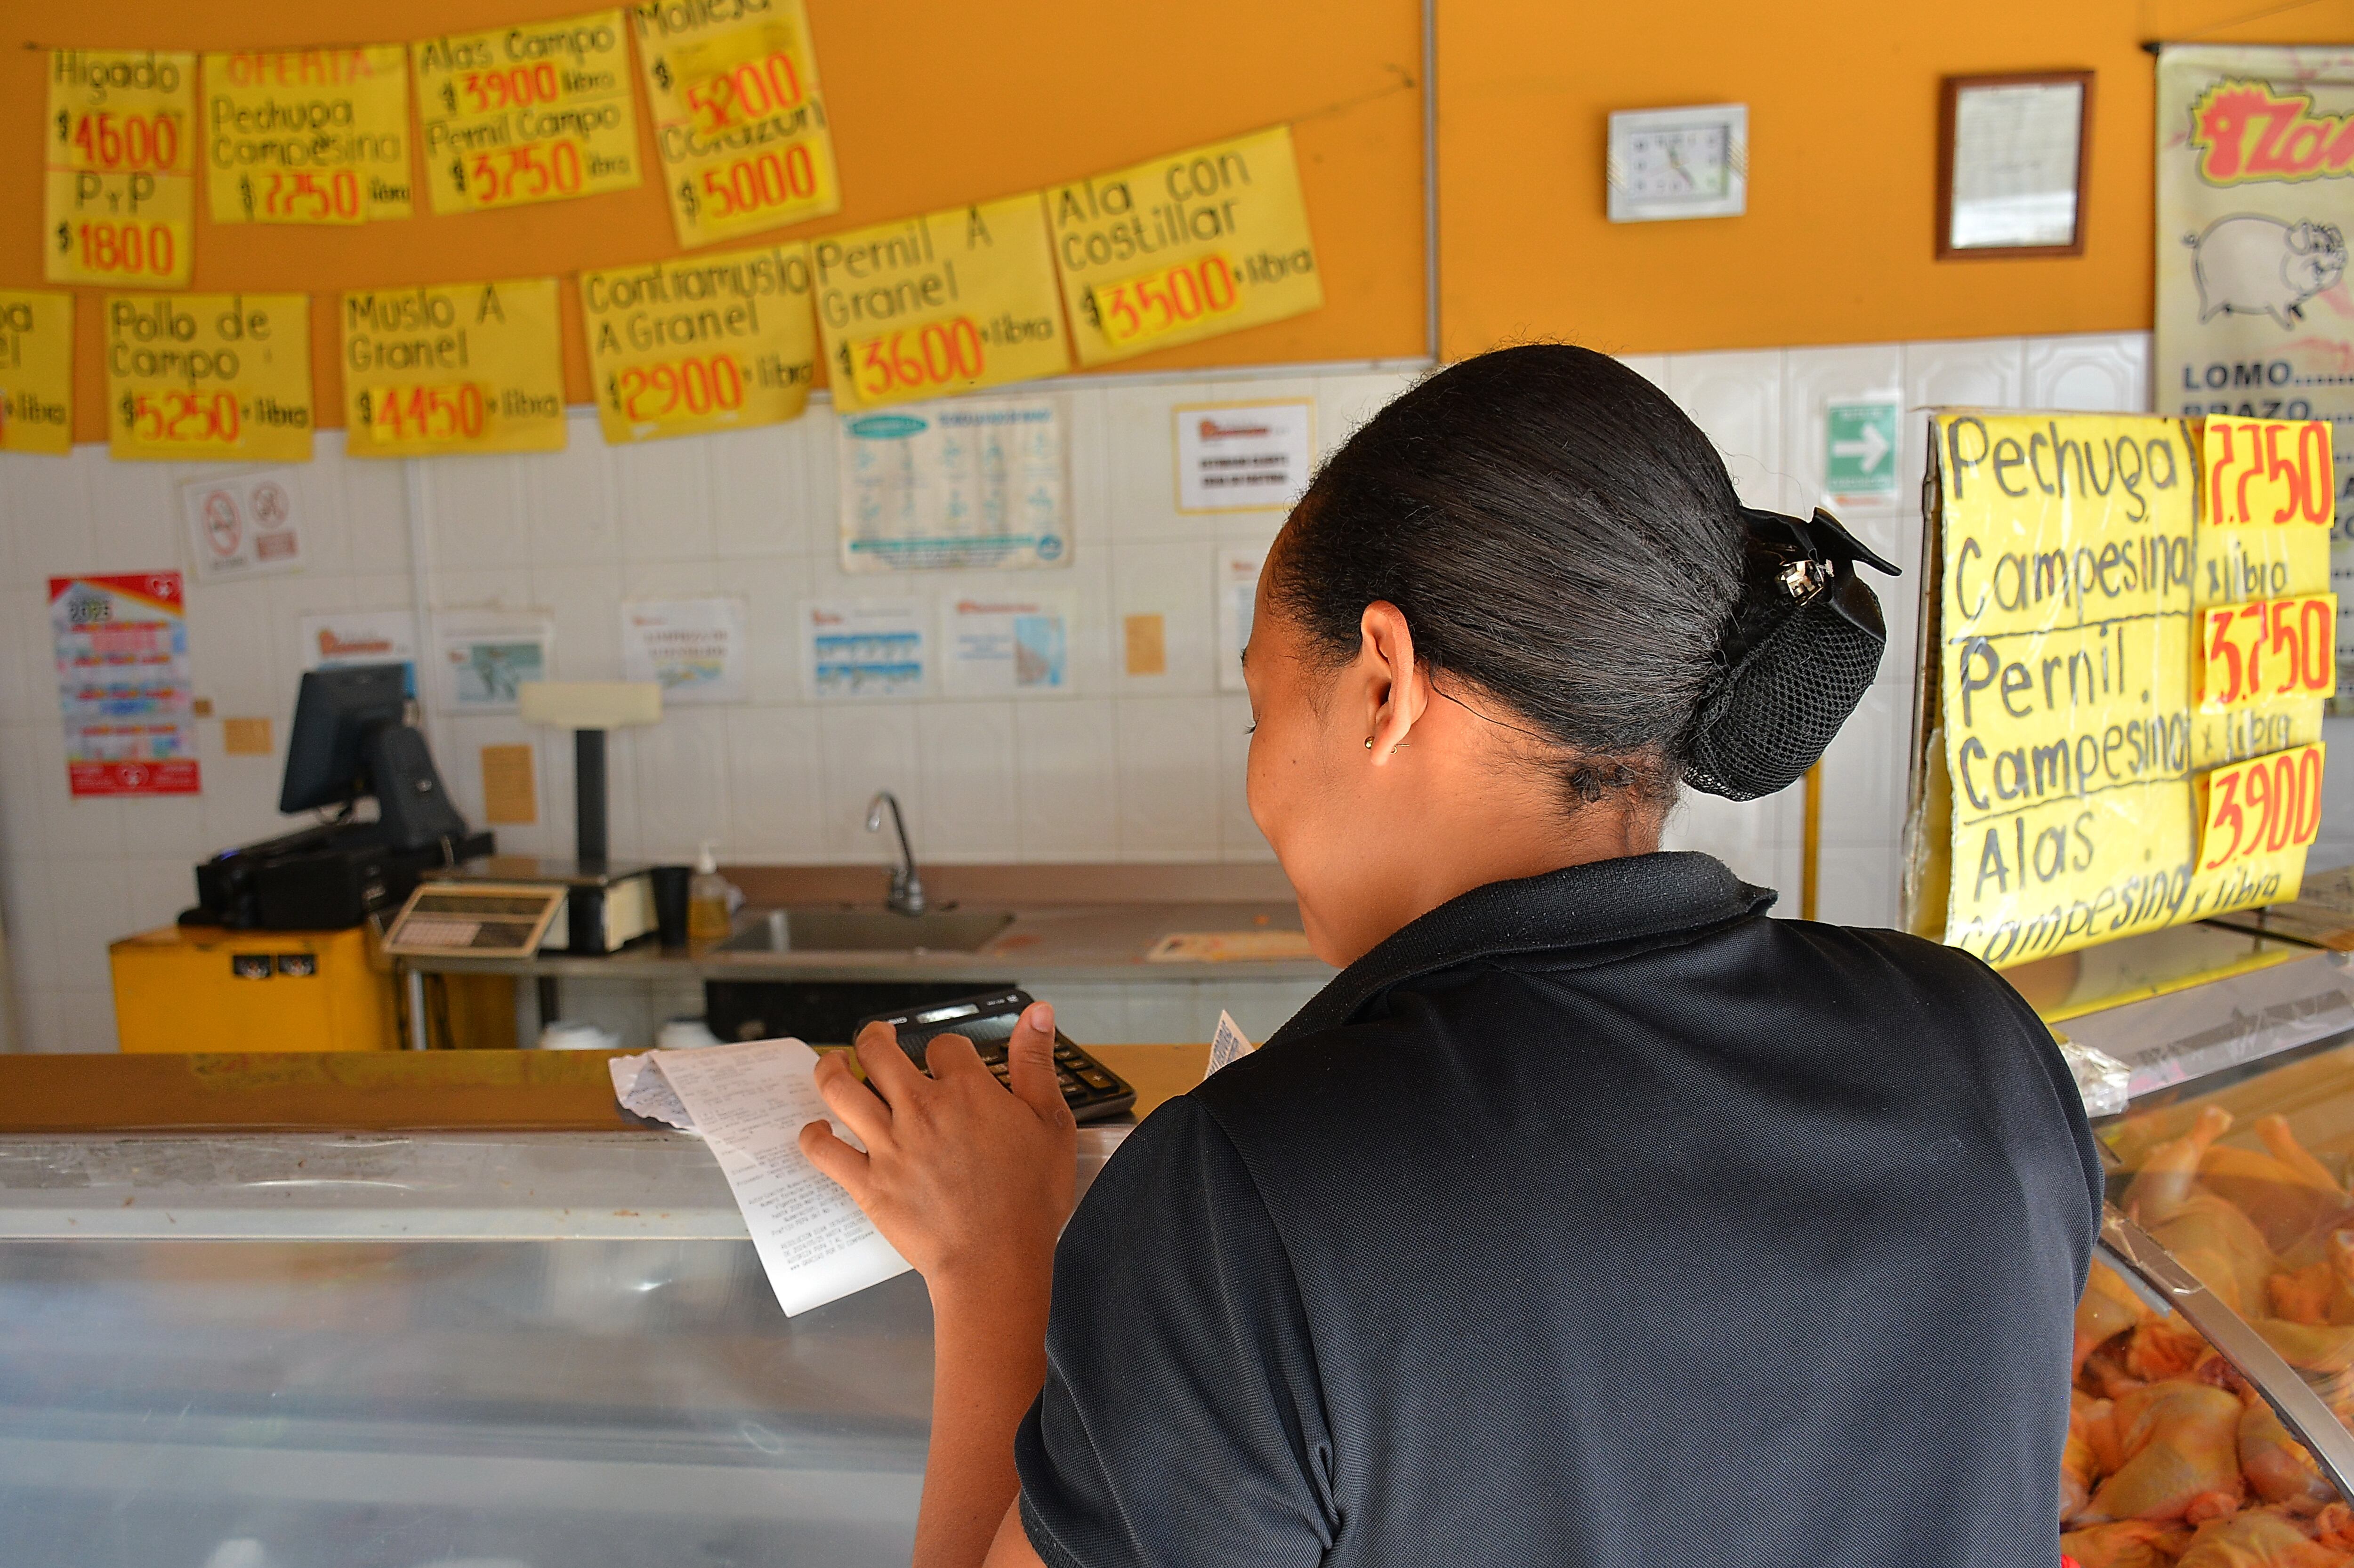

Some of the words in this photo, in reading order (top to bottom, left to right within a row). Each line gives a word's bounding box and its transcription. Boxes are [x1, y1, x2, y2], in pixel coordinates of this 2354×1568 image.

[421, 37, 494, 74] Alas
[505, 26, 614, 67] Campo
[210, 94, 355, 141] Pechuga
[426, 113, 512, 158] Pernil
[516, 103, 621, 141] Campo
[211, 131, 401, 169] Campesina
[1059, 178, 1134, 229] Ala
[816, 213, 935, 286] Pernil
[967, 205, 994, 250] A
[347, 287, 456, 332] Muslo
[476, 283, 506, 325] A
[586, 247, 811, 314] Contramuslo
[822, 258, 959, 330] Granel
[111, 300, 198, 342] Pollo
[215, 293, 272, 341] de
[596, 321, 623, 357] A
[627, 299, 760, 352] Granel
[109, 341, 240, 388] Campo
[347, 328, 469, 371] Granel
[1948, 417, 2178, 522] Pechuga
[1957, 535, 2192, 627] Campesina
[1960, 711, 2191, 811] Campesina
[1974, 811, 2096, 903] Alas
